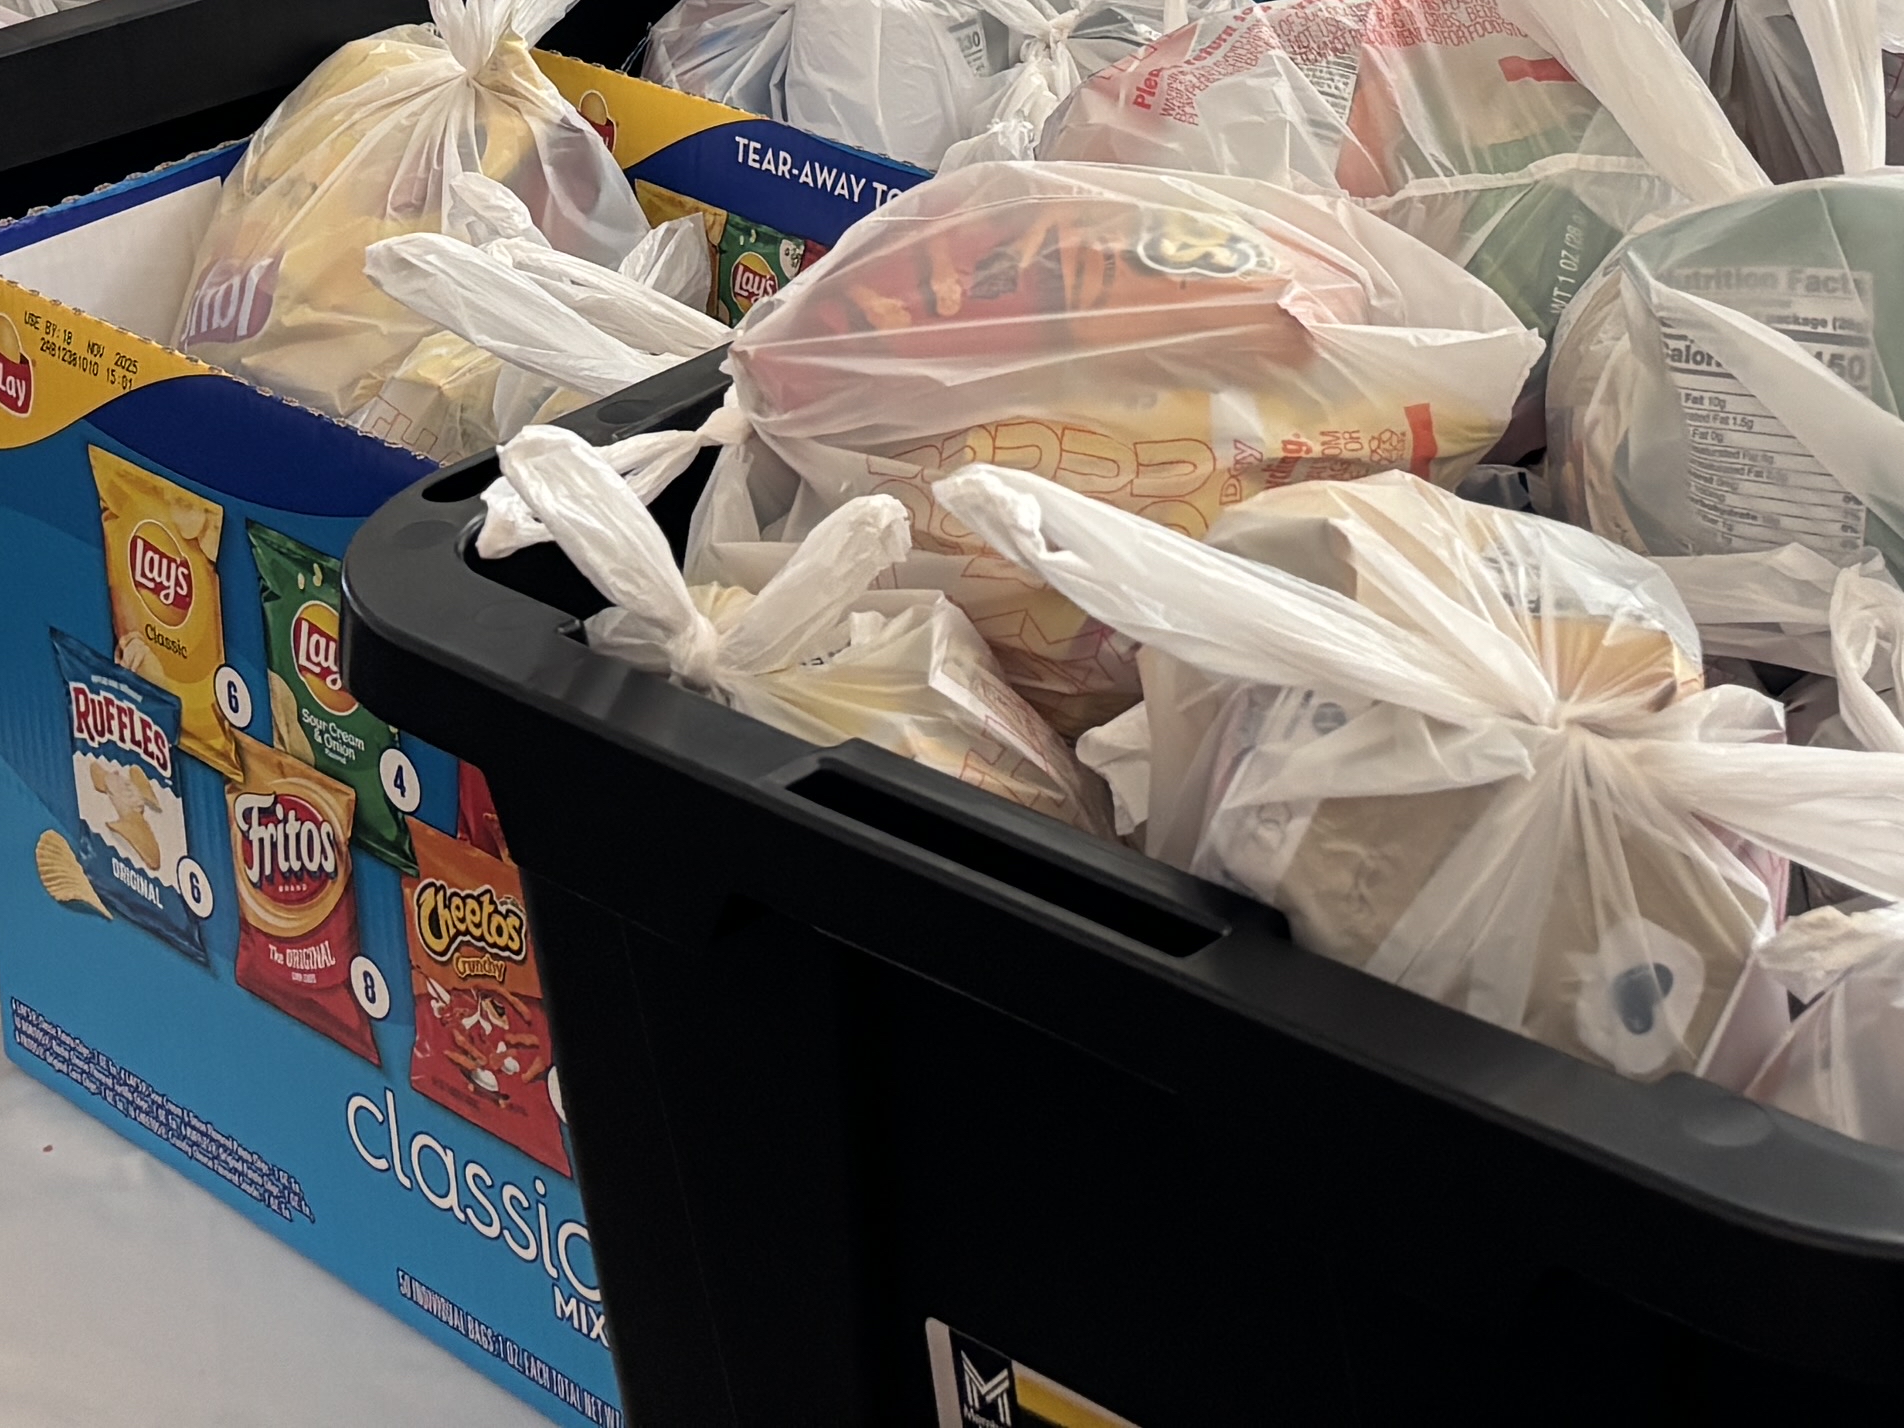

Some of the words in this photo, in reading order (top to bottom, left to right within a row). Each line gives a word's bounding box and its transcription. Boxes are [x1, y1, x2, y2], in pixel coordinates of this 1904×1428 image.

[1183, 24, 1238, 67] return
[734, 135, 867, 203] TEAR-AWAY
[23, 310, 42, 332] USE
[63, 328, 73, 345] 18
[86, 340, 106, 358] NOV
[113, 351, 139, 375] 2025
[134, 536, 189, 606] Lay's
[144, 622, 189, 660] Classic
[227, 679, 240, 715] 6
[70, 683, 173, 778] RUFFLES
[301, 707, 329, 733] Sour
[328, 720, 365, 752] Cream
[313, 727, 323, 745] &
[323, 732, 356, 761] Onion
[393, 764, 406, 799] 4
[234, 792, 337, 888] Fritos
[110, 855, 165, 911] ORIGINAL
[186, 873, 204, 906] 6
[414, 878, 527, 962] Cheetos
[268, 943, 284, 965] The
[285, 940, 337, 971] ORIGINAL
[452, 951, 507, 984] Crunchy
[362, 969, 378, 1005] 8
[345, 1087, 604, 1305] classic
[398, 1268, 411, 1299] 50
[411, 1277, 467, 1338] INDIVIDUAL
[523, 1350, 551, 1390] EACH
[552, 1368, 583, 1412] TOTAL
[552, 1282, 612, 1348] MIX
